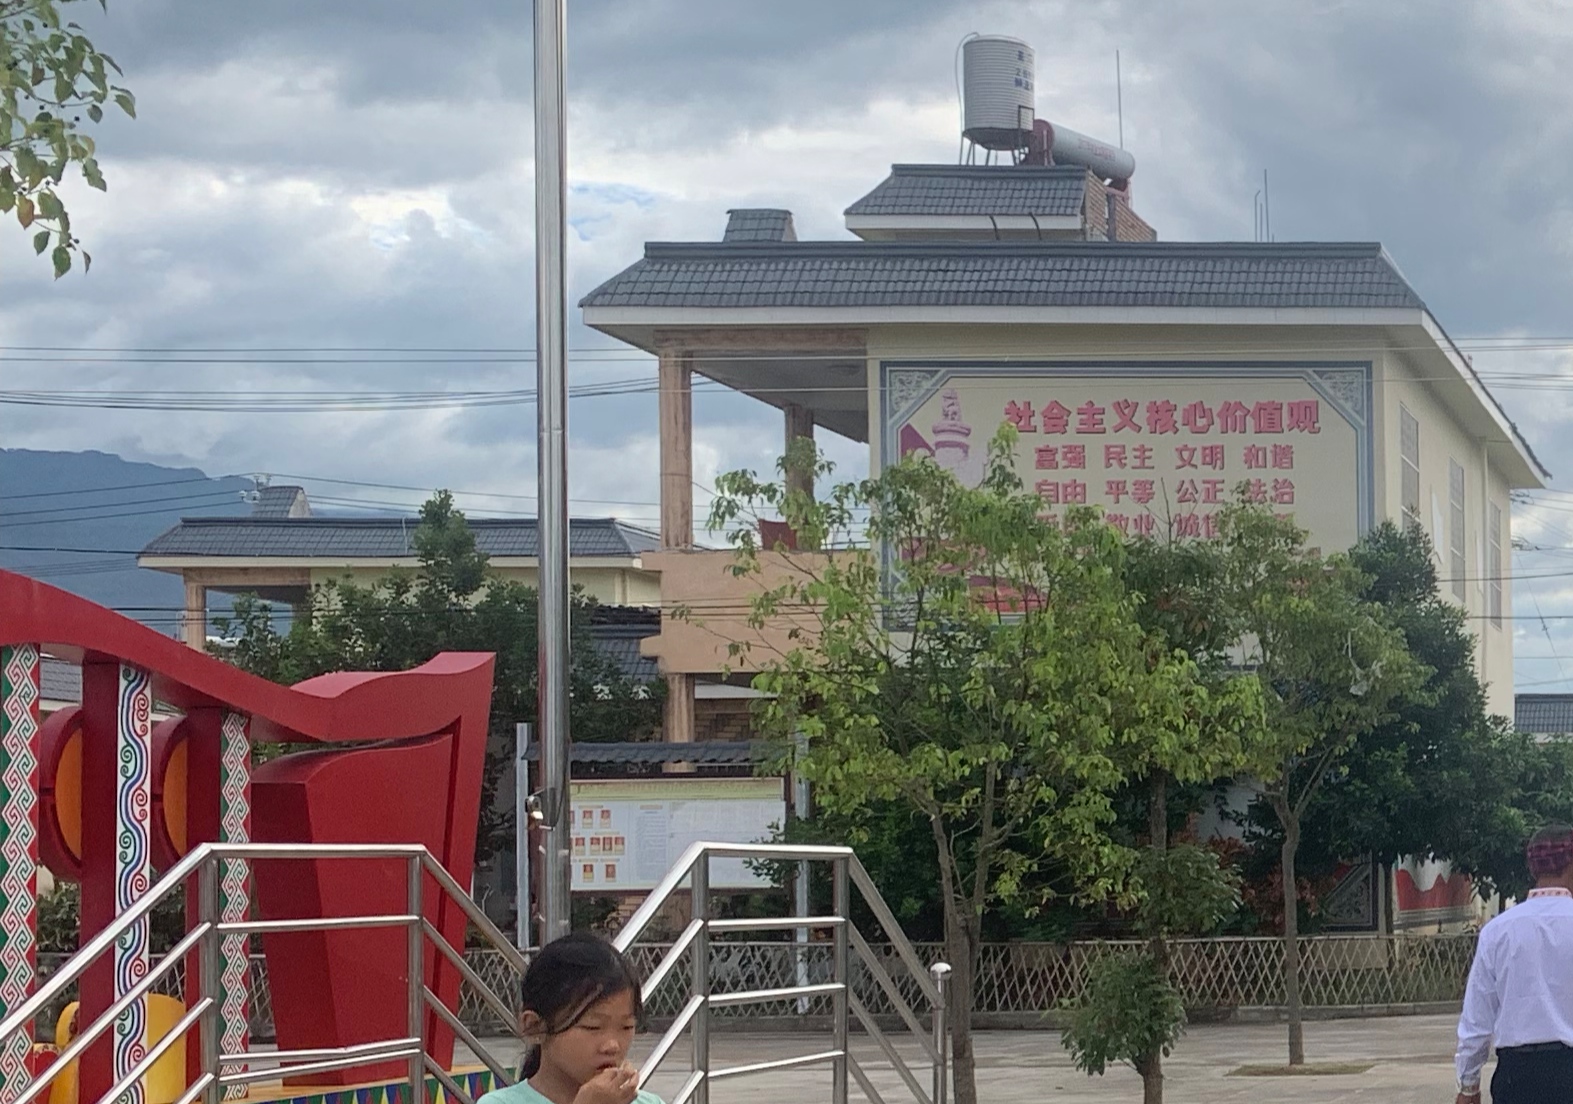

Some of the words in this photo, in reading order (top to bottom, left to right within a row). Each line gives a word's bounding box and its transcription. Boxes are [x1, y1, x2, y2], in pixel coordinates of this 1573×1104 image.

[1004, 399, 1321, 434] 社会主义核心价值观
[1034, 443, 1086, 471] 富强
[1104, 444, 1155, 470] 民主
[1175, 444, 1225, 470] 文明
[1243, 444, 1294, 470] 和谐
[1034, 478, 1087, 504] 自由
[1105, 479, 1156, 504] 平等
[1176, 478, 1225, 504] 公正
[1246, 478, 1294, 505] 法治
